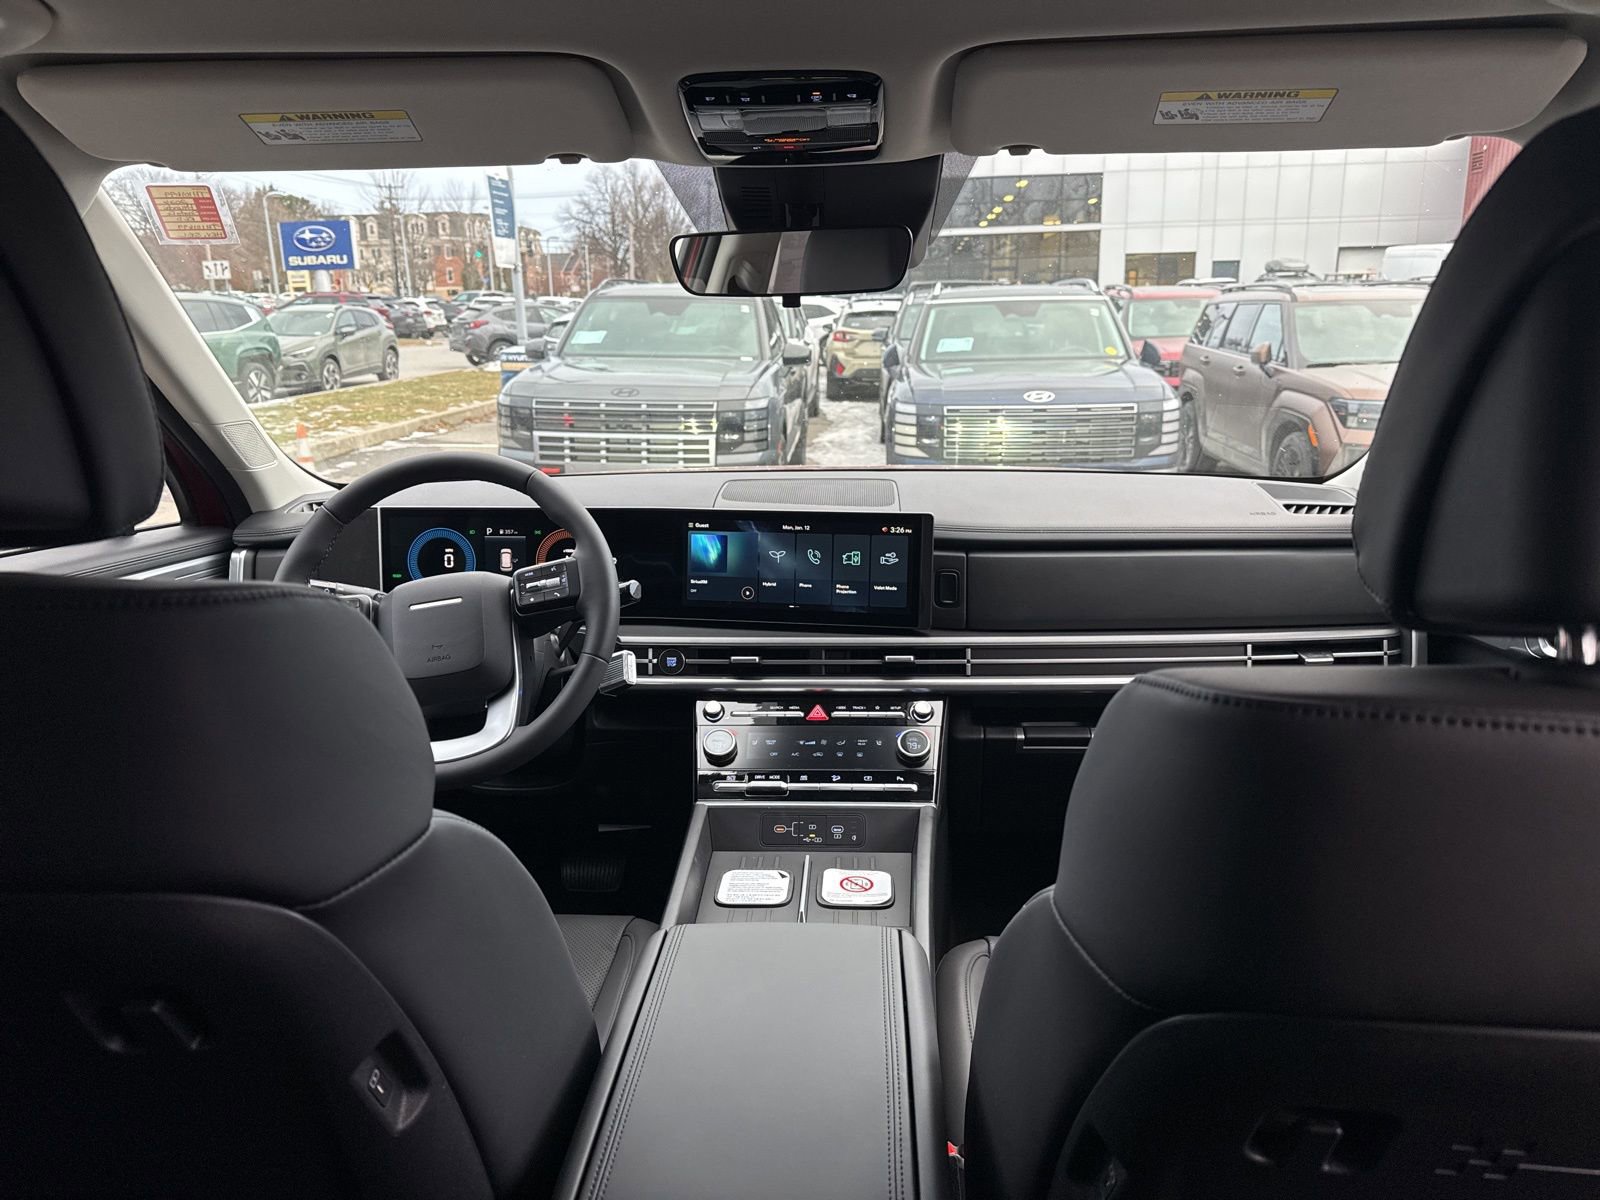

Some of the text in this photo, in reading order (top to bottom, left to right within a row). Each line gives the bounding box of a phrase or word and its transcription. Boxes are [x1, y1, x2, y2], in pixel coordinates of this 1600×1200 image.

[1217, 90, 1300, 99] WARNING
[296, 111, 376, 121] WARNING
[288, 254, 348, 266] SUBARU
[486, 527, 493, 535] P
[890, 526, 904, 534] 3:26
[444, 553, 454, 568] 0
[427, 654, 451, 663] AIRBAG
